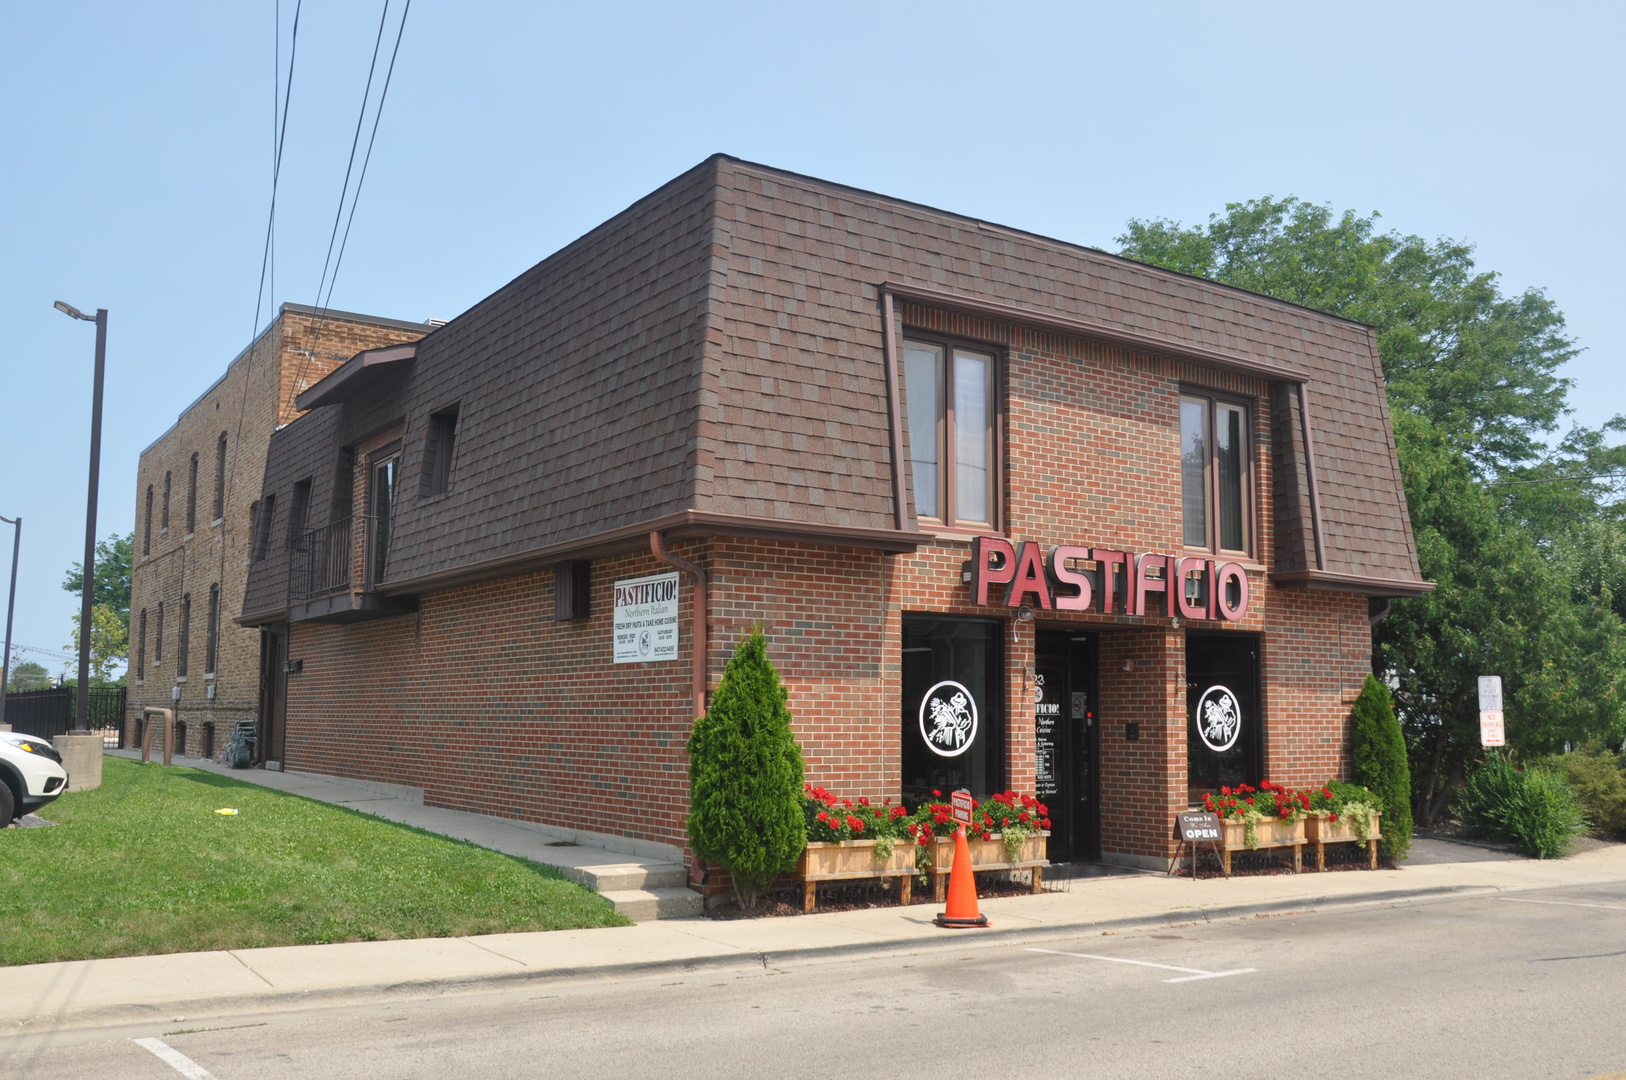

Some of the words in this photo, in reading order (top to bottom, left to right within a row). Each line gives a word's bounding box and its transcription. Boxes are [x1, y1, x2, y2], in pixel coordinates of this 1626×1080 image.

[972, 536, 1248, 621] PASTIFICIO
[615, 580, 677, 607] PASTIFICIO!
[625, 606, 650, 618] Northern
[651, 603, 669, 615] Italian
[615, 622, 625, 630] FRESH
[632, 620, 642, 629] PASTA
[646, 619, 655, 627] TAKE
[655, 617, 664, 625] HOME
[665, 616, 677, 624] CUISINE
[953, 797, 970, 810] PASTIFICIO
[954, 808, 969, 821] PARKING
[1185, 829, 1218, 839] OPEN
